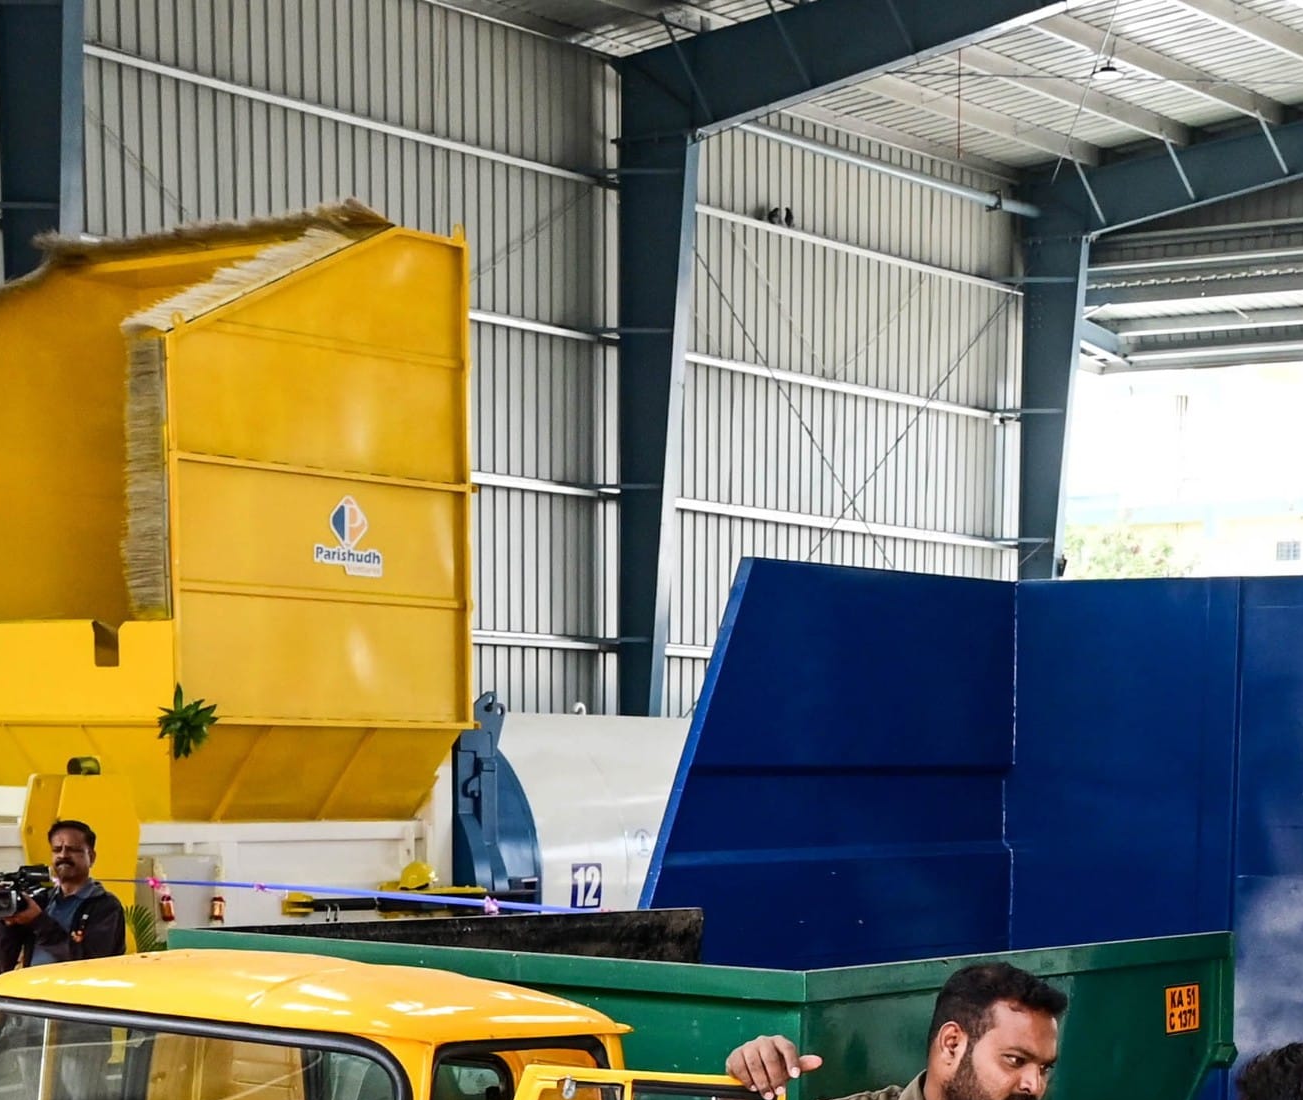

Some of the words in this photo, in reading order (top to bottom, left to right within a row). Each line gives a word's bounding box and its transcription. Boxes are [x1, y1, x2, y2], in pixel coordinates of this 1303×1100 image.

[316, 546, 381, 564] Parishudh
[574, 865, 600, 907] 12
[1170, 989, 1184, 1008] KA
[1186, 987, 1196, 1006] 51
[1169, 1012, 1176, 1030] C
[1178, 1008, 1197, 1029] 1371
